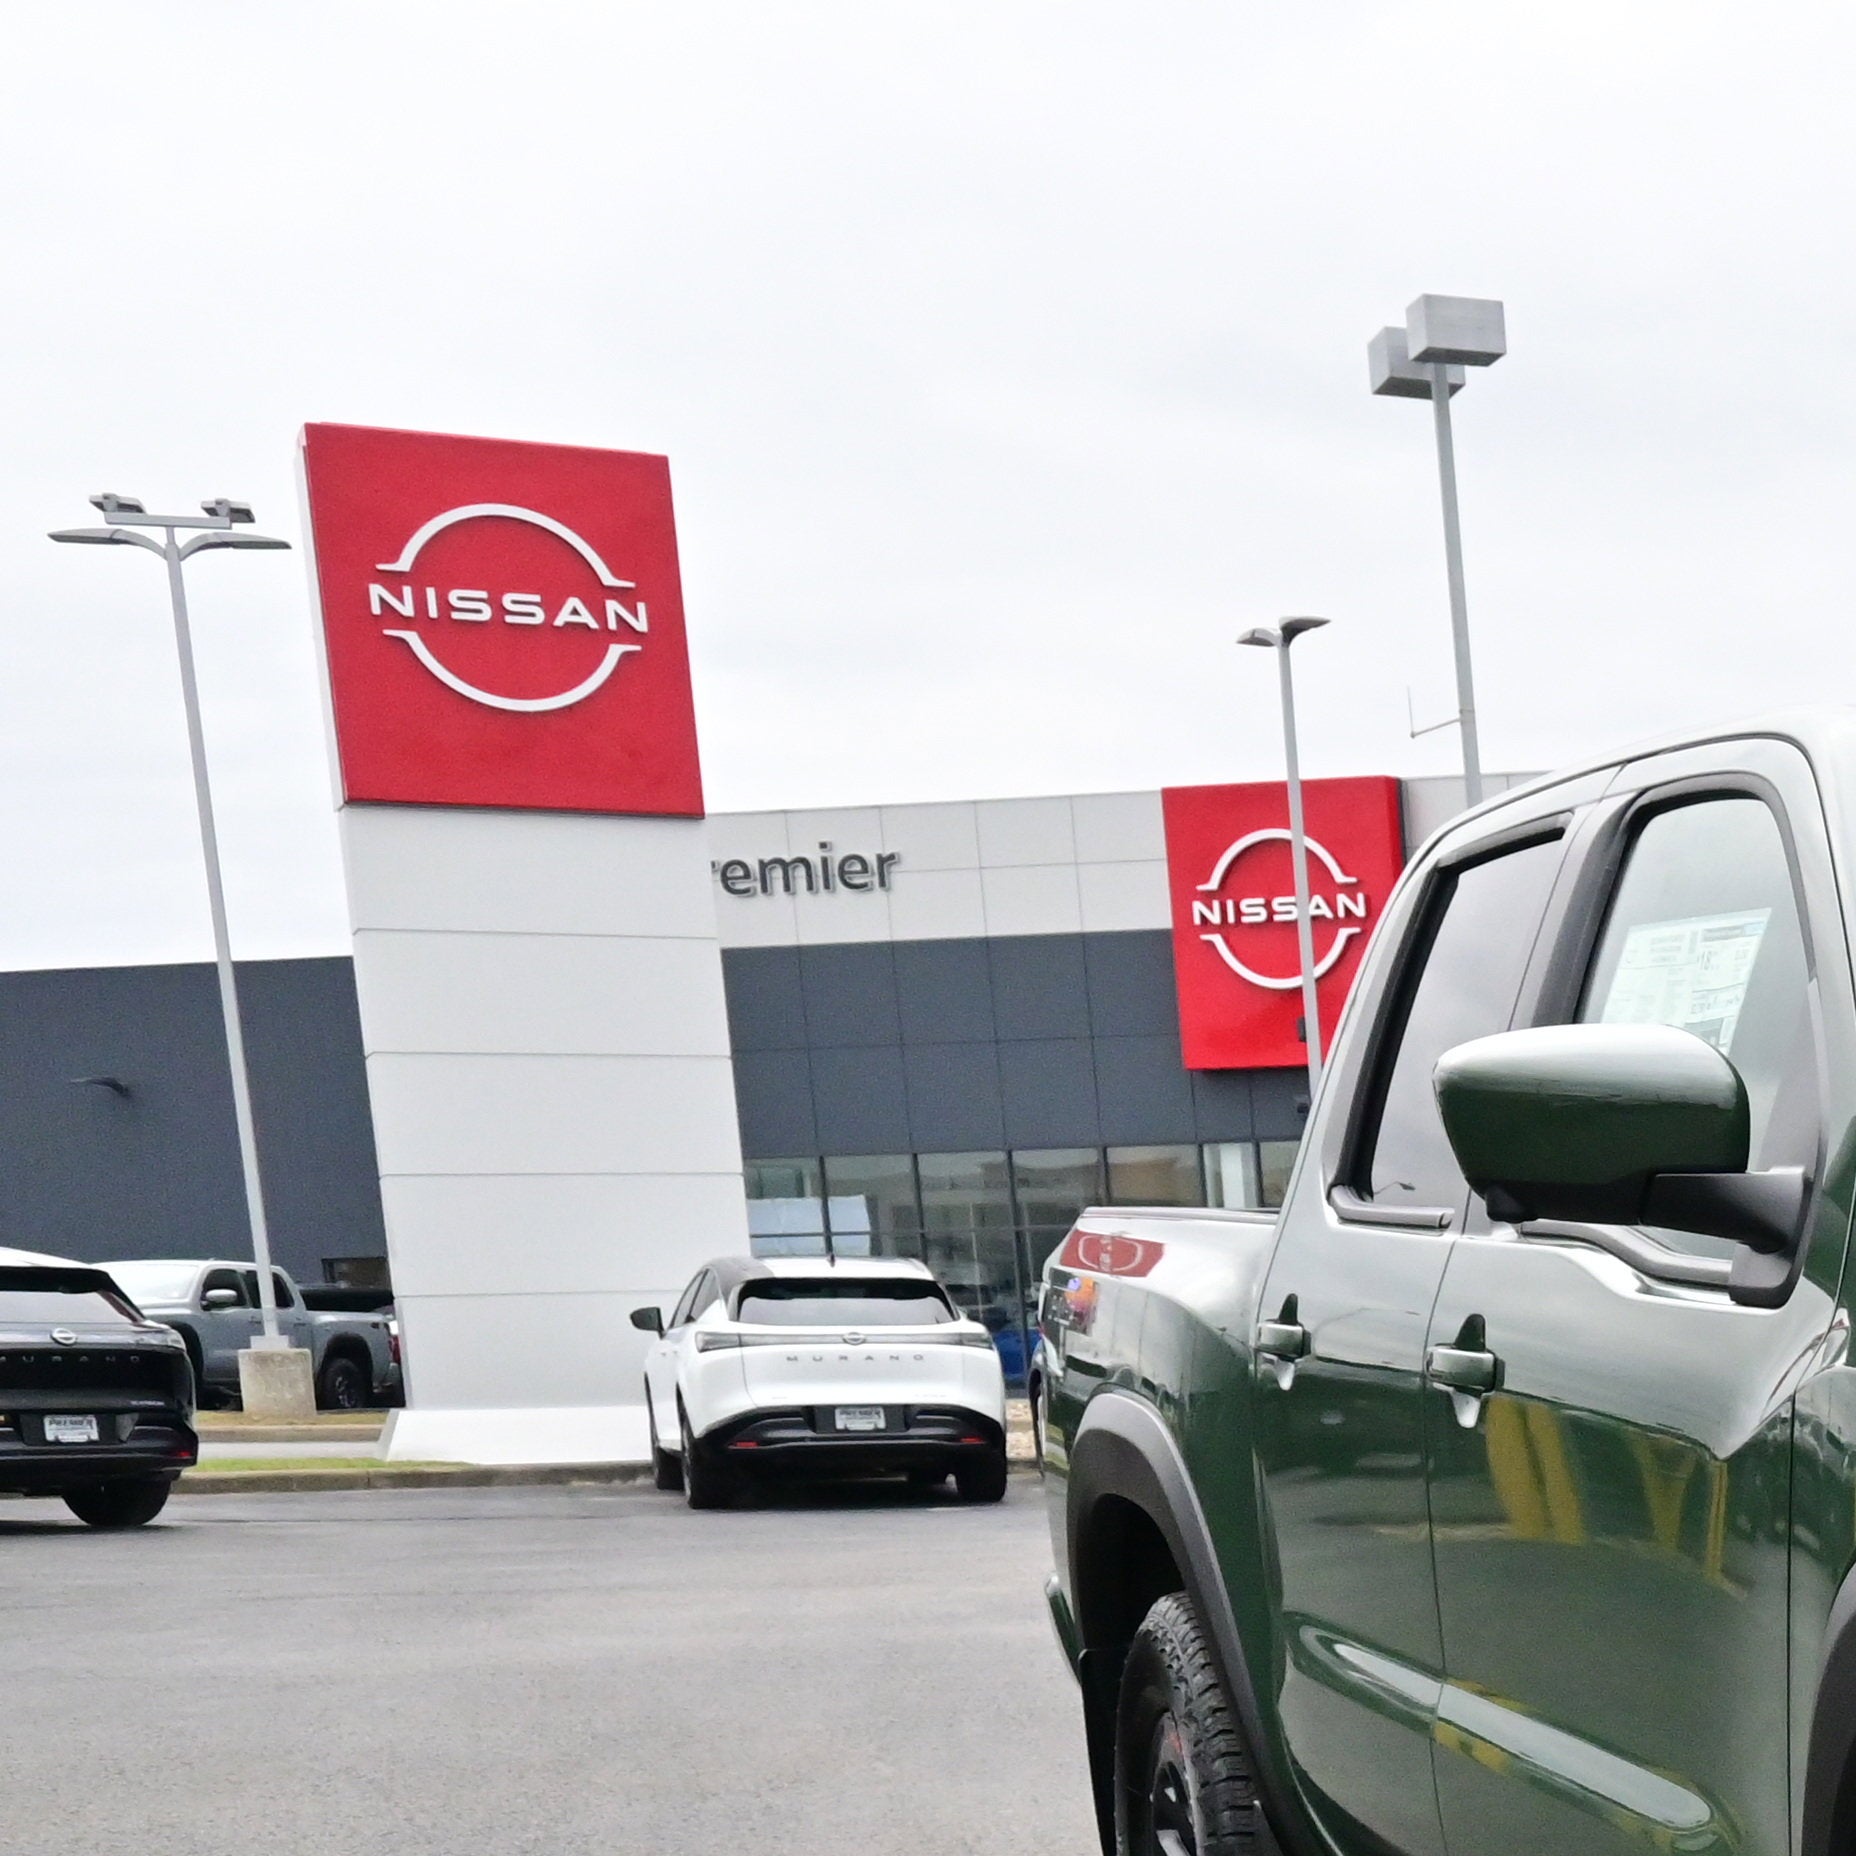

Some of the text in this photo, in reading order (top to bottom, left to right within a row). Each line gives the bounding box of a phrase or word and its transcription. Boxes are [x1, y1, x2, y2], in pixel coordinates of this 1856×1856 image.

[368, 583, 649, 634] NISSAN
[711, 841, 900, 896] emier
[1192, 892, 1366, 925] NISSAN
